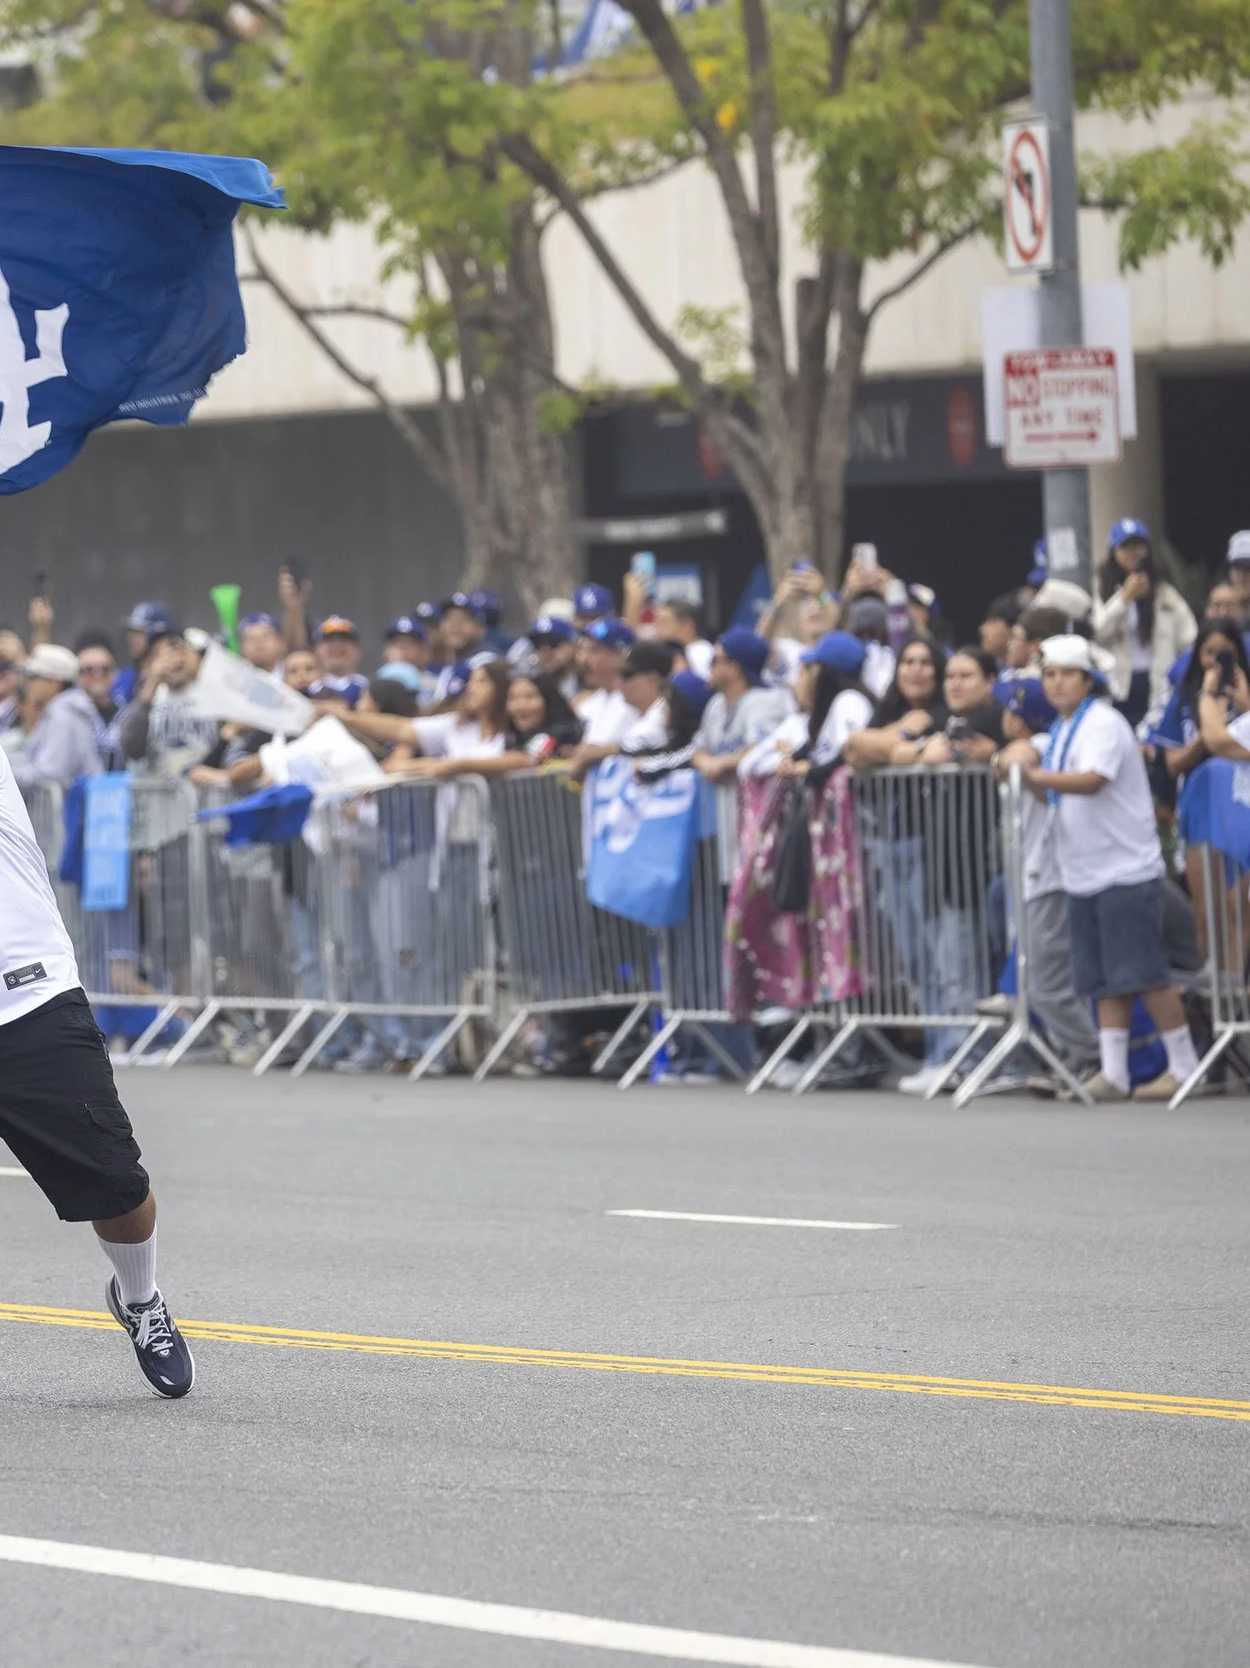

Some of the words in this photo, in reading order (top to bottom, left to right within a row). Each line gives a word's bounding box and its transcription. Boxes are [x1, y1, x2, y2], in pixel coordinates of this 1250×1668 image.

[1007, 379, 1039, 403] NO
[1043, 377, 1116, 398] STOPPING
[1021, 410, 1054, 428] ANY
[1065, 406, 1104, 427] TIME
